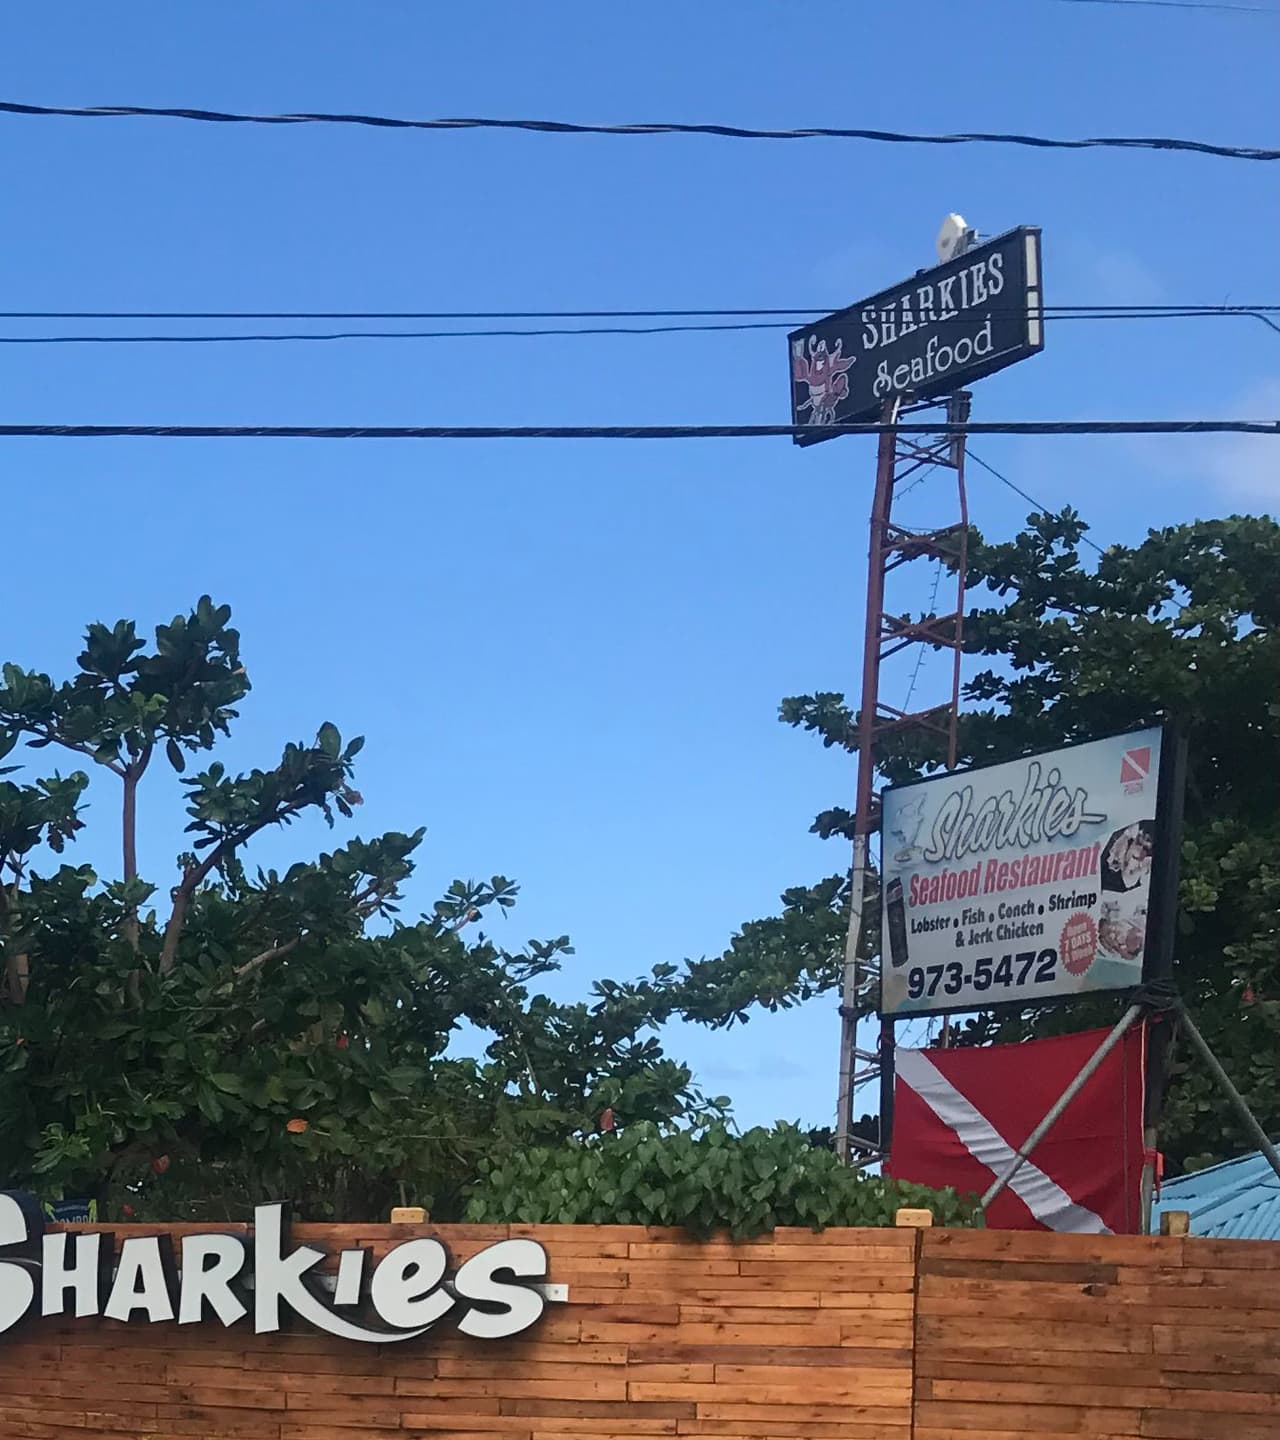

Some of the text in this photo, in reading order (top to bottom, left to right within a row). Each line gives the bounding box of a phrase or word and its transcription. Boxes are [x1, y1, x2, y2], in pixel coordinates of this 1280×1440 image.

[861, 253, 1004, 350] SHARKIES
[873, 314, 995, 398] Seafood
[923, 761, 1107, 863] Sharkies
[908, 841, 1101, 908] Seafood Restaurant
[911, 890, 1097, 934] Lobster Fish Conch Shrimp
[955, 922, 1044, 948] & Jerk Chicken
[908, 948, 1058, 999] 973-5472
